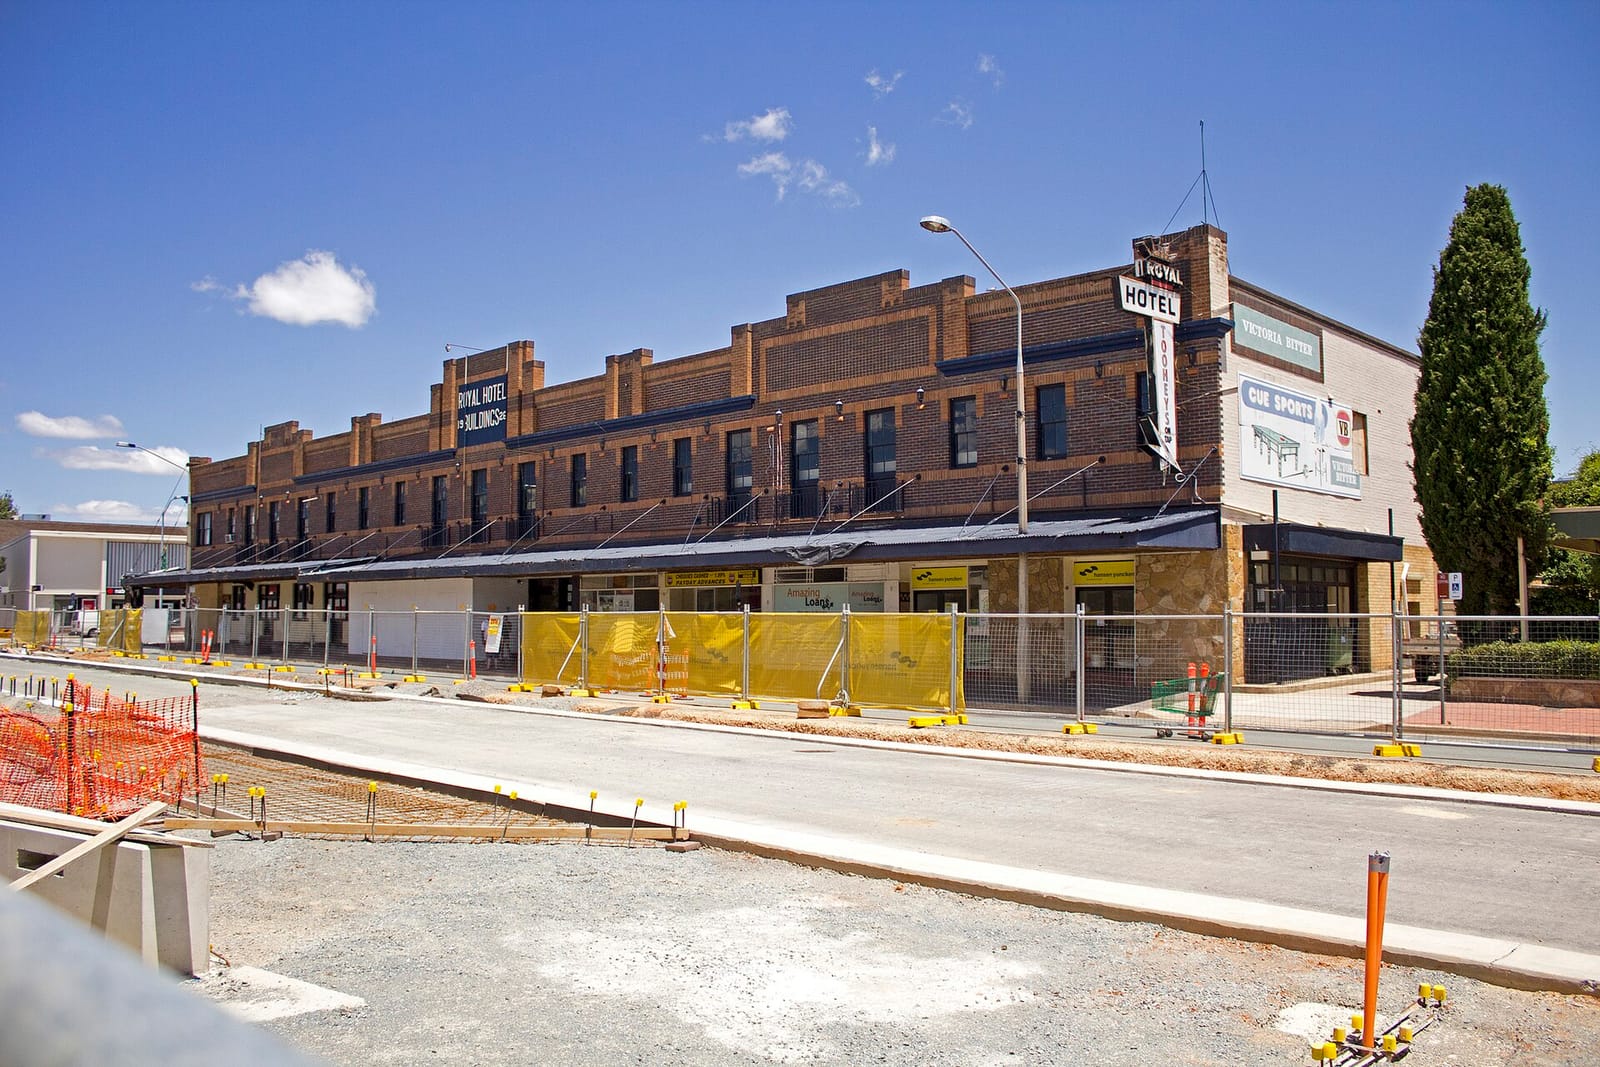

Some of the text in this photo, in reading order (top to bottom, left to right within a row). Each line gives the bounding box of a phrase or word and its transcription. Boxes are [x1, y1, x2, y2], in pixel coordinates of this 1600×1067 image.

[1146, 261, 1184, 285] ROYAL
[1126, 285, 1176, 316] HOTEL
[1242, 319, 1313, 356] VICTORIA BITTER
[1160, 325, 1170, 426] TOOHEYS
[458, 382, 507, 409] ROYAL HOTEL
[1248, 386, 1313, 420] CUE SPORTS
[464, 408, 500, 431] BUILDINGS
[1339, 420, 1349, 436] VB
[787, 587, 820, 598] Amazing
[805, 597, 830, 607] Loans
